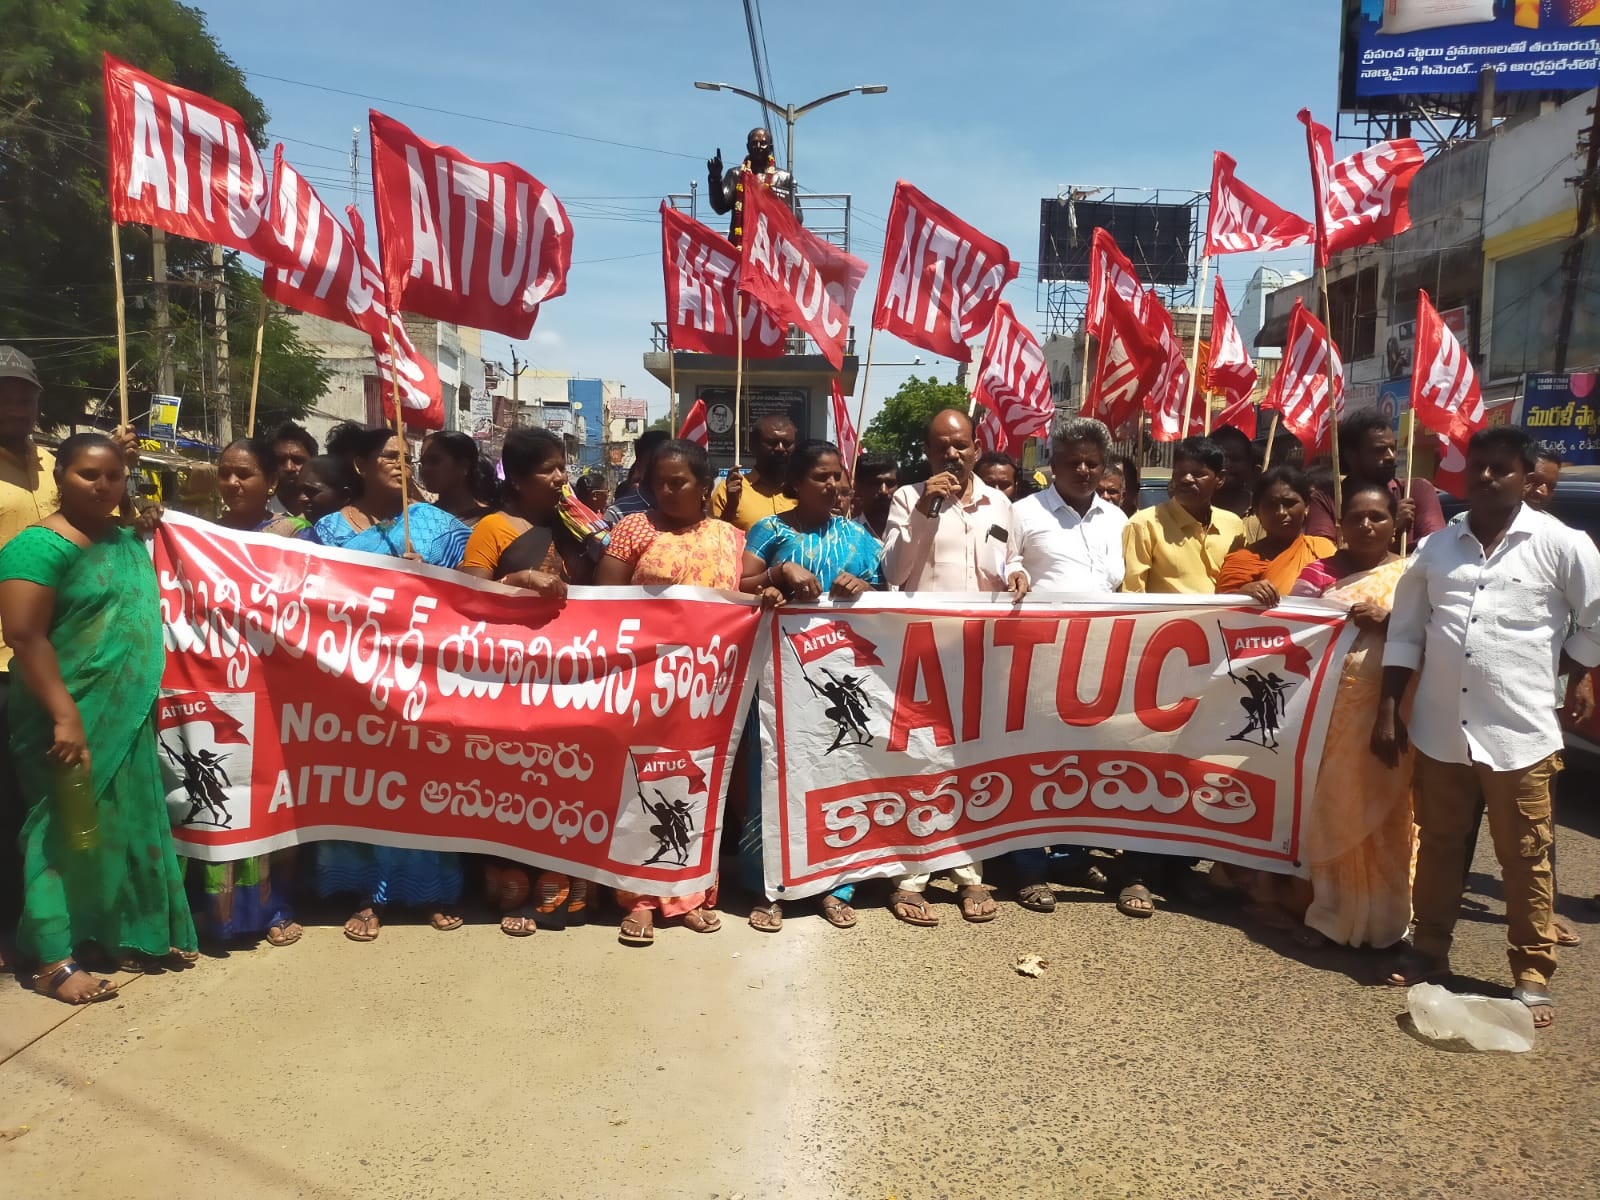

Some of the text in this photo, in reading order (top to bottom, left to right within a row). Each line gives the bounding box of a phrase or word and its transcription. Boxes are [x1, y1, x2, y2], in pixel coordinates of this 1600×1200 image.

[405, 144, 565, 313] AITUC
[750, 212, 846, 338] AITUC
[884, 205, 1006, 344] AITUC
[651, 635, 739, 719] కావలి
[803, 629, 847, 653] AITUC
[1235, 635, 1285, 650] AITUC
[161, 702, 207, 720] AITUC
[886, 618, 1210, 752] AITUC
[465, 734, 594, 785] నెల్లూరు
[643, 758, 687, 774] AITUC
[268, 765, 609, 844] AITUC అనుబంధం
[821, 755, 1256, 848] కావలి సమితి
